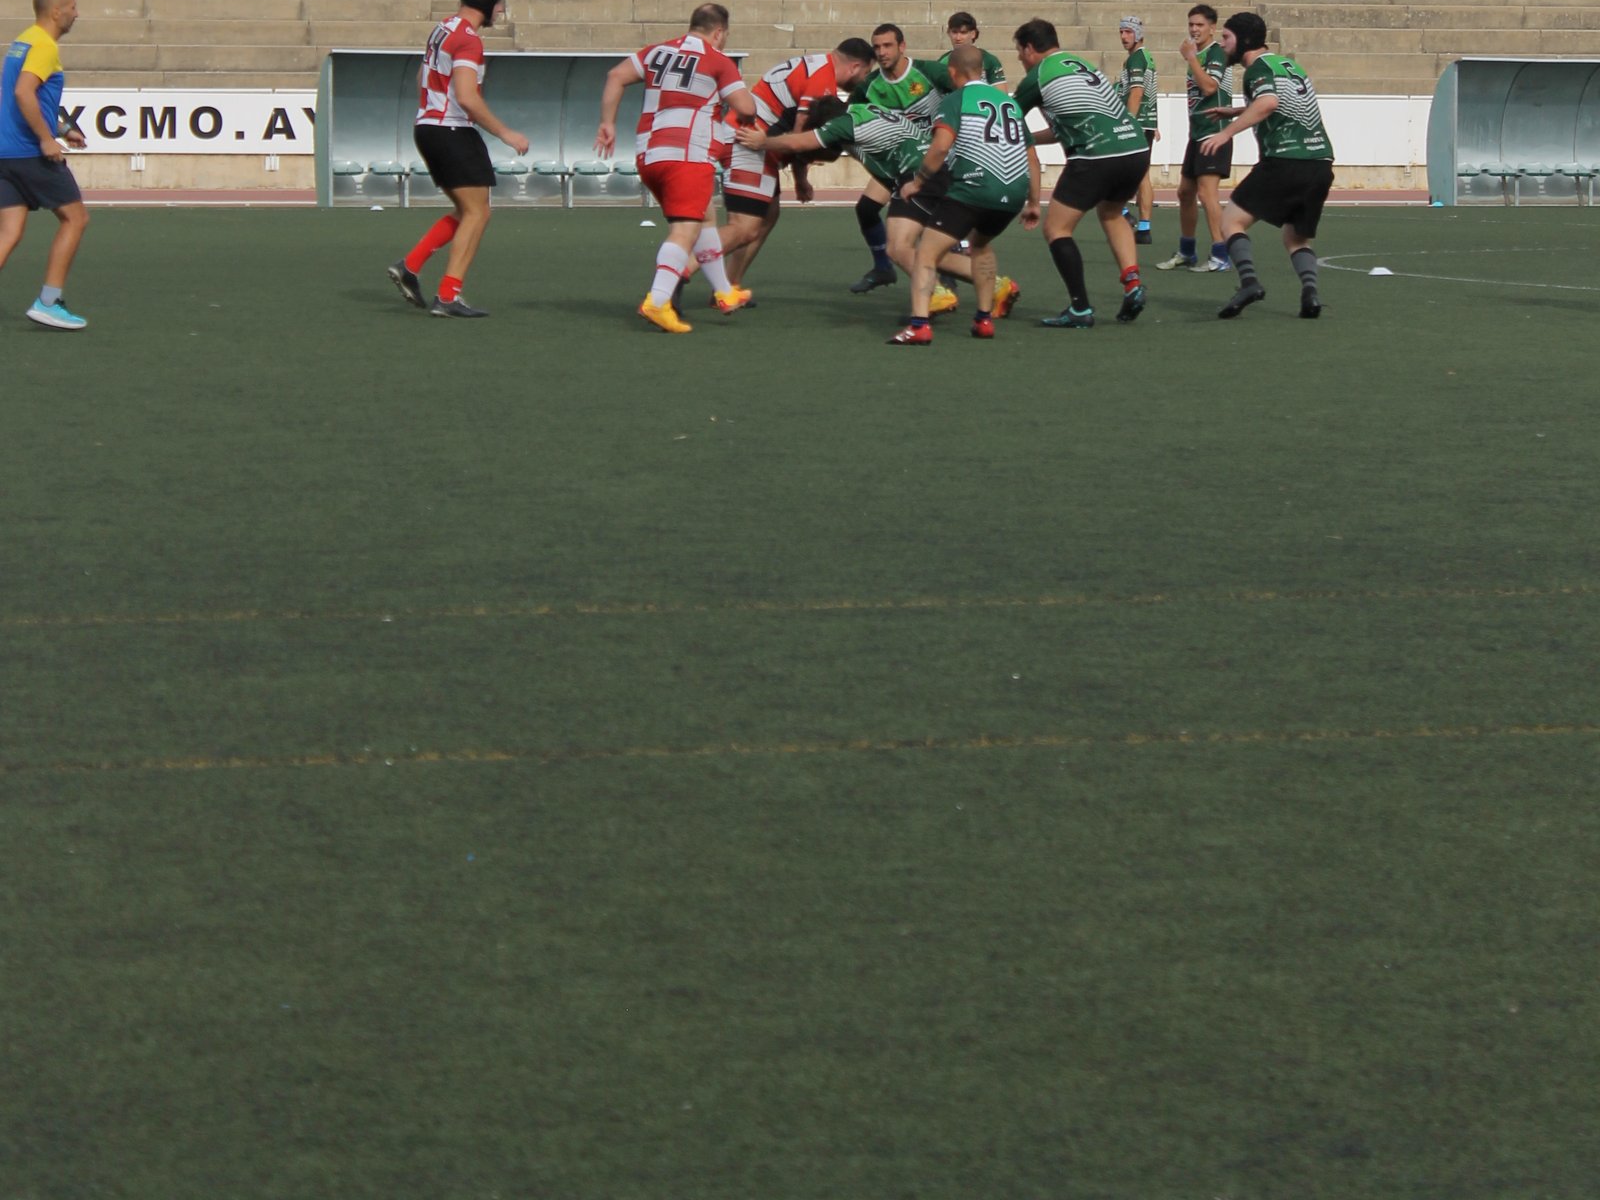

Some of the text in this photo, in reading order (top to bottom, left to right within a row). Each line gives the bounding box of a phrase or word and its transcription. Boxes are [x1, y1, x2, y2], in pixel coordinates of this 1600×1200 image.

[648, 49, 699, 91] 44
[1061, 59, 1101, 88] 3
[1280, 61, 1308, 96] 5
[978, 100, 1021, 146] 26
